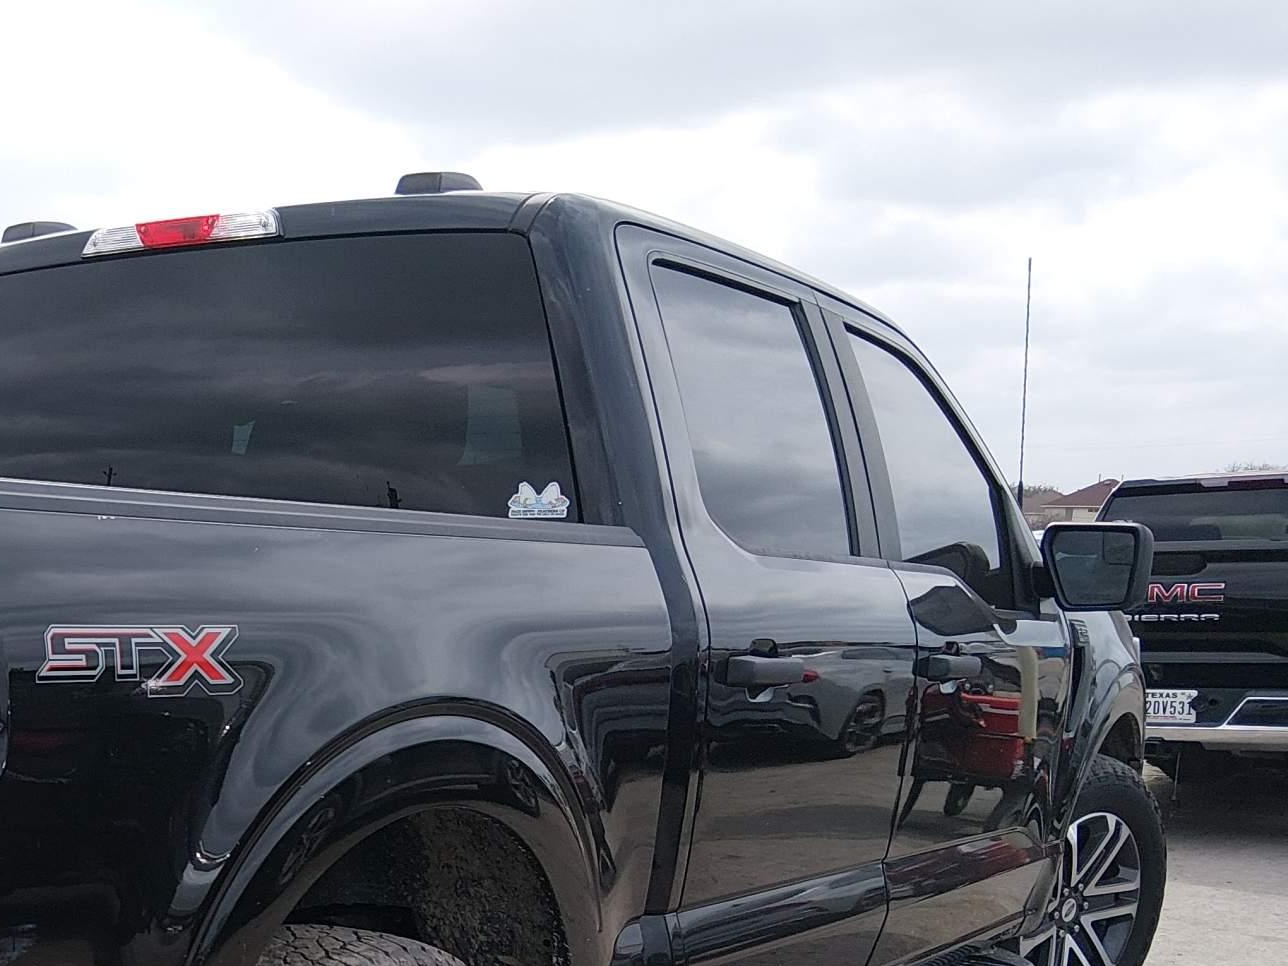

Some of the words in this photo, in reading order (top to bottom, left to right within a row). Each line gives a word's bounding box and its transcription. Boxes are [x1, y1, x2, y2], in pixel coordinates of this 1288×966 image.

[1148, 583, 1225, 602] MC
[37, 625, 243, 696] STX
[1145, 700, 1193, 716] 20V531
